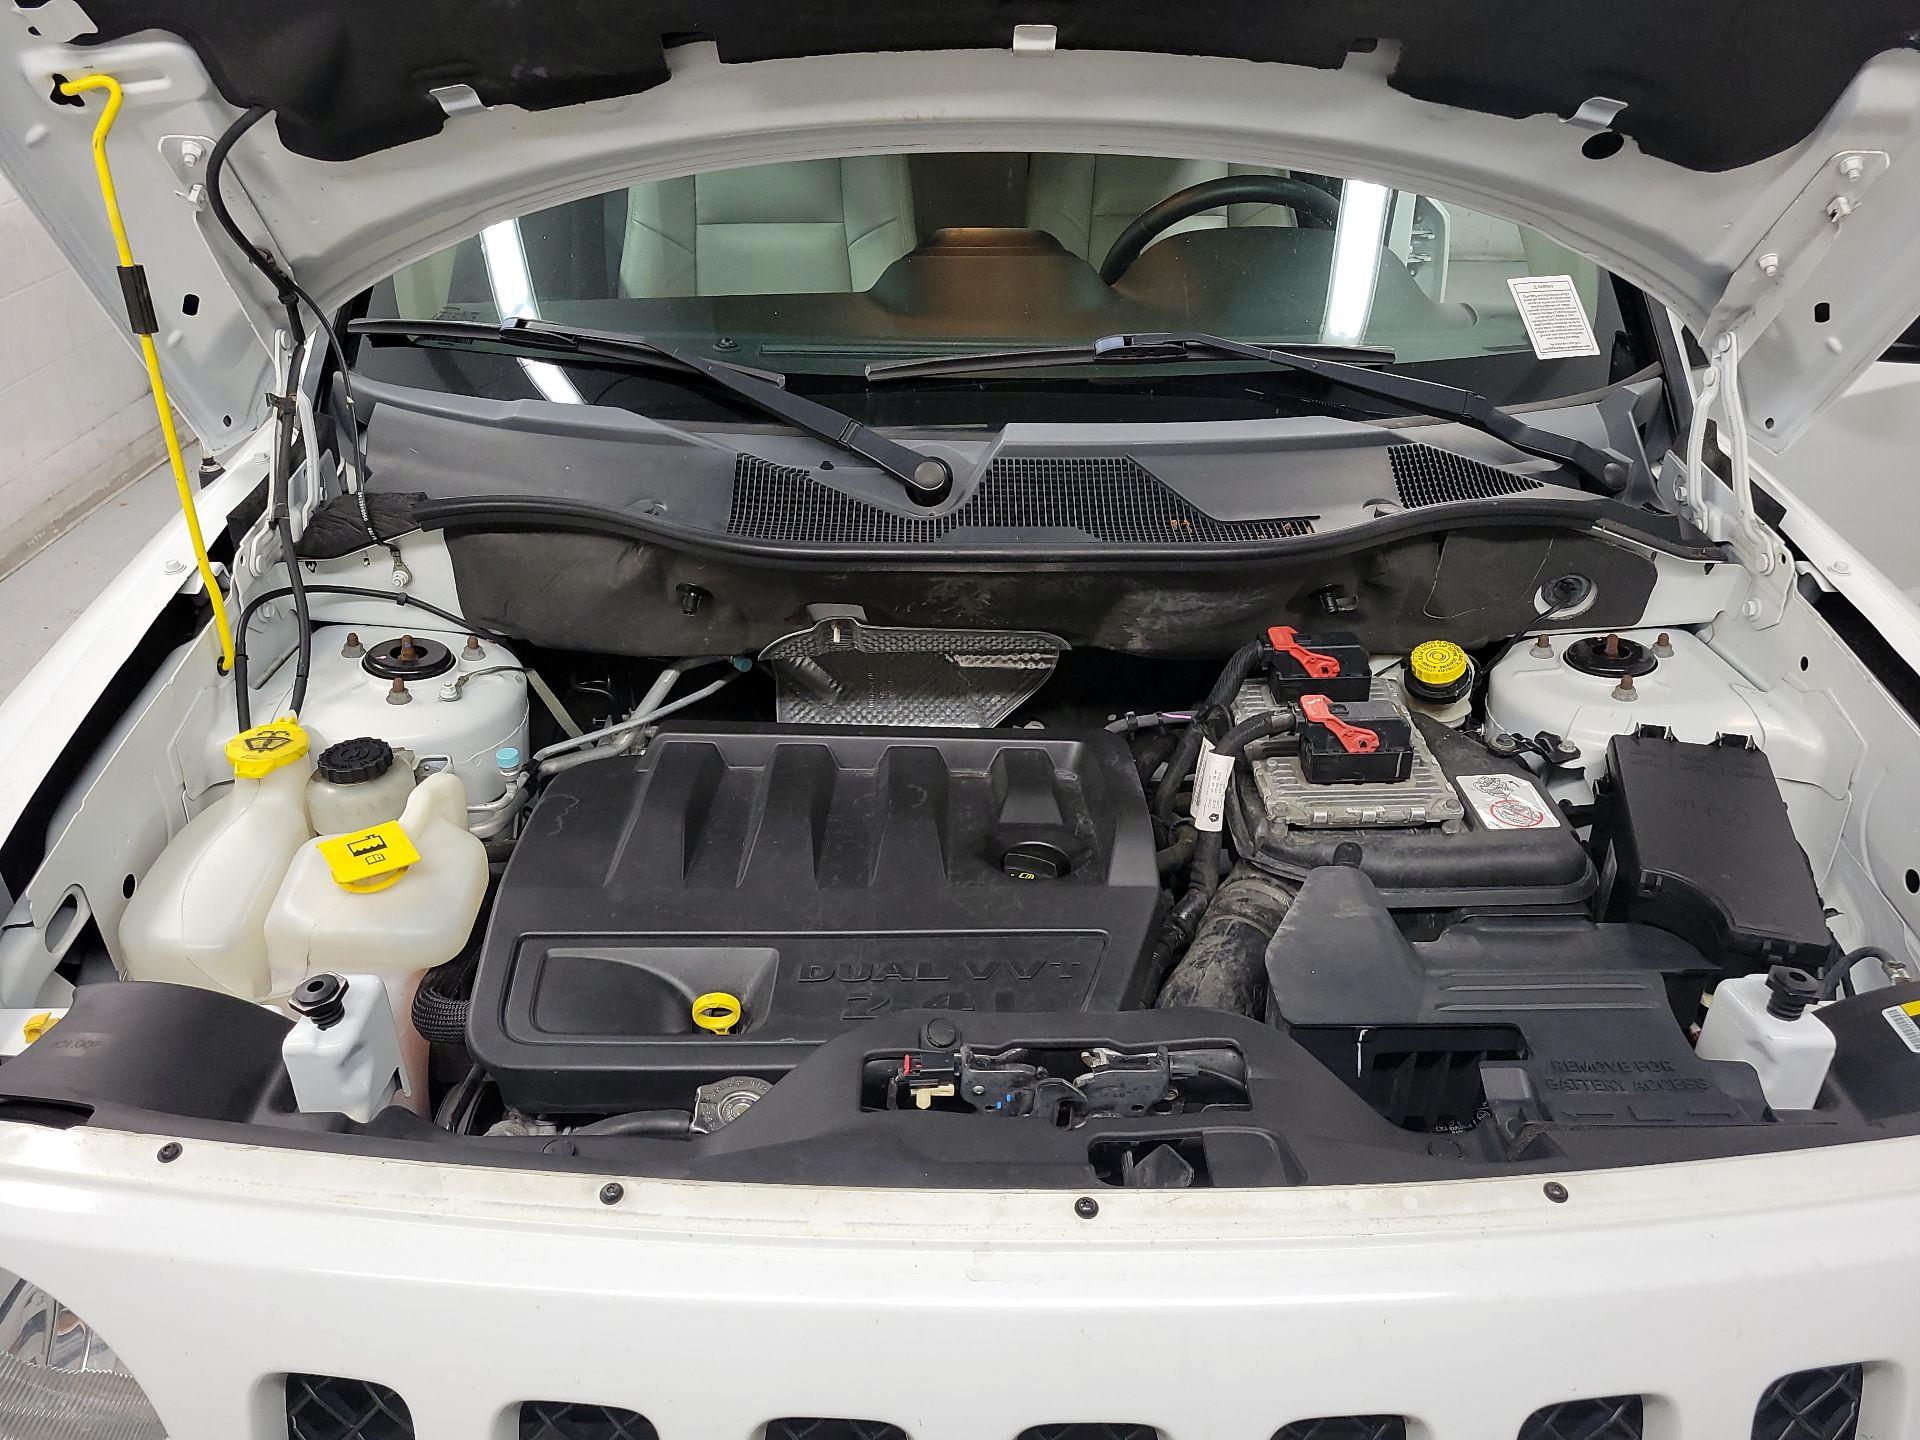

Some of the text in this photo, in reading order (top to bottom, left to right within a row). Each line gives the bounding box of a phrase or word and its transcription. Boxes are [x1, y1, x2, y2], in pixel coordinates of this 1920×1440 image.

[797, 960, 1082, 983] DUAL VVT
[839, 990, 1015, 1021] 24
[1550, 1060, 1676, 1074] REMOVE FOR
[1545, 1077, 1710, 1092] BATTERY ACCESS
